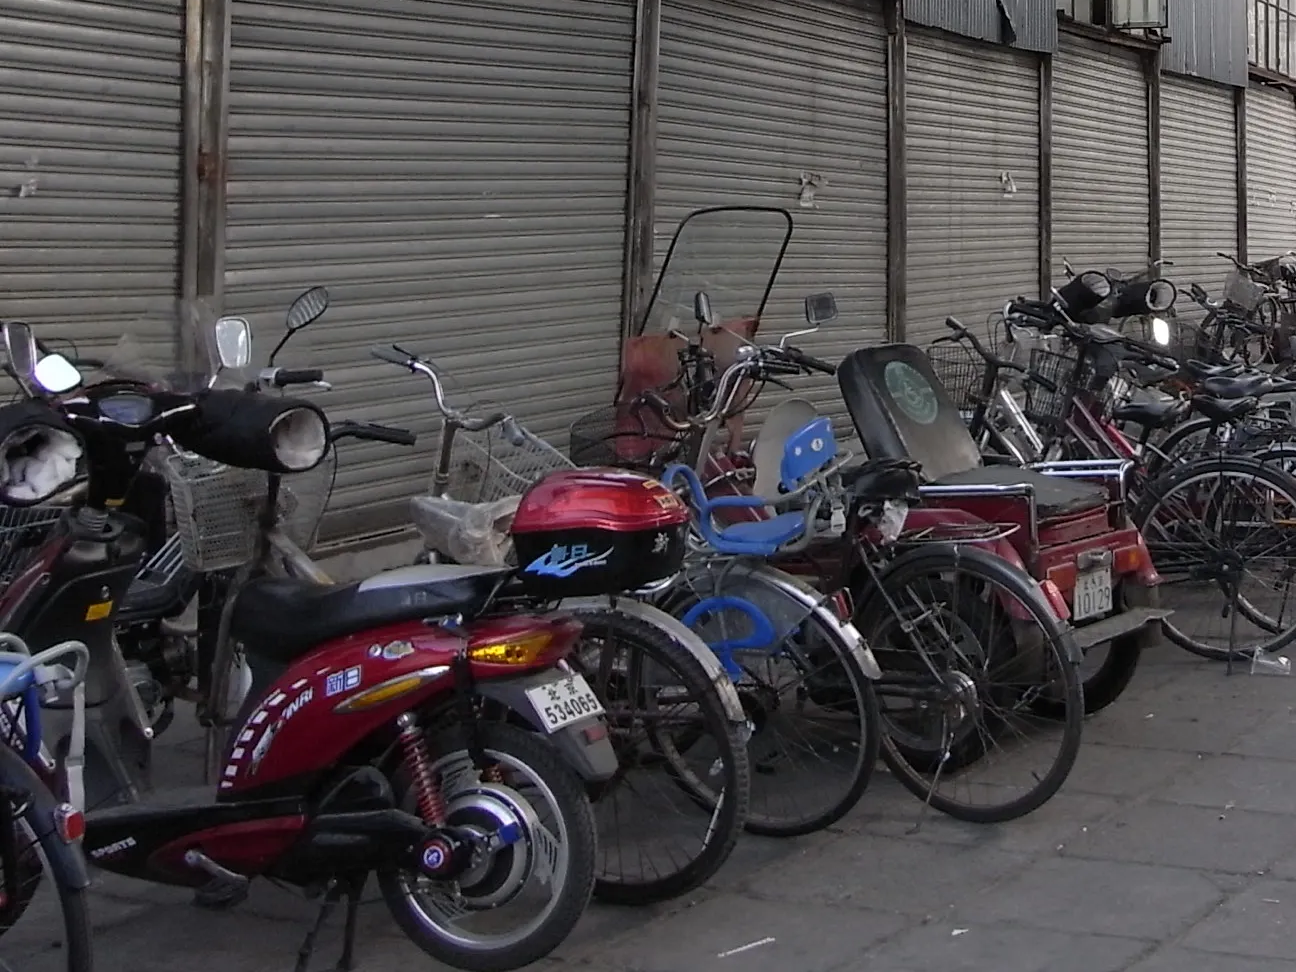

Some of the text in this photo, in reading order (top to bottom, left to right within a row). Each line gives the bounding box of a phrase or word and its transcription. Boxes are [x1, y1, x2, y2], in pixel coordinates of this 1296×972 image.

[1078, 586, 1111, 616] 10129
[326, 664, 362, 697] 新日
[544, 693, 599, 725] 534065
